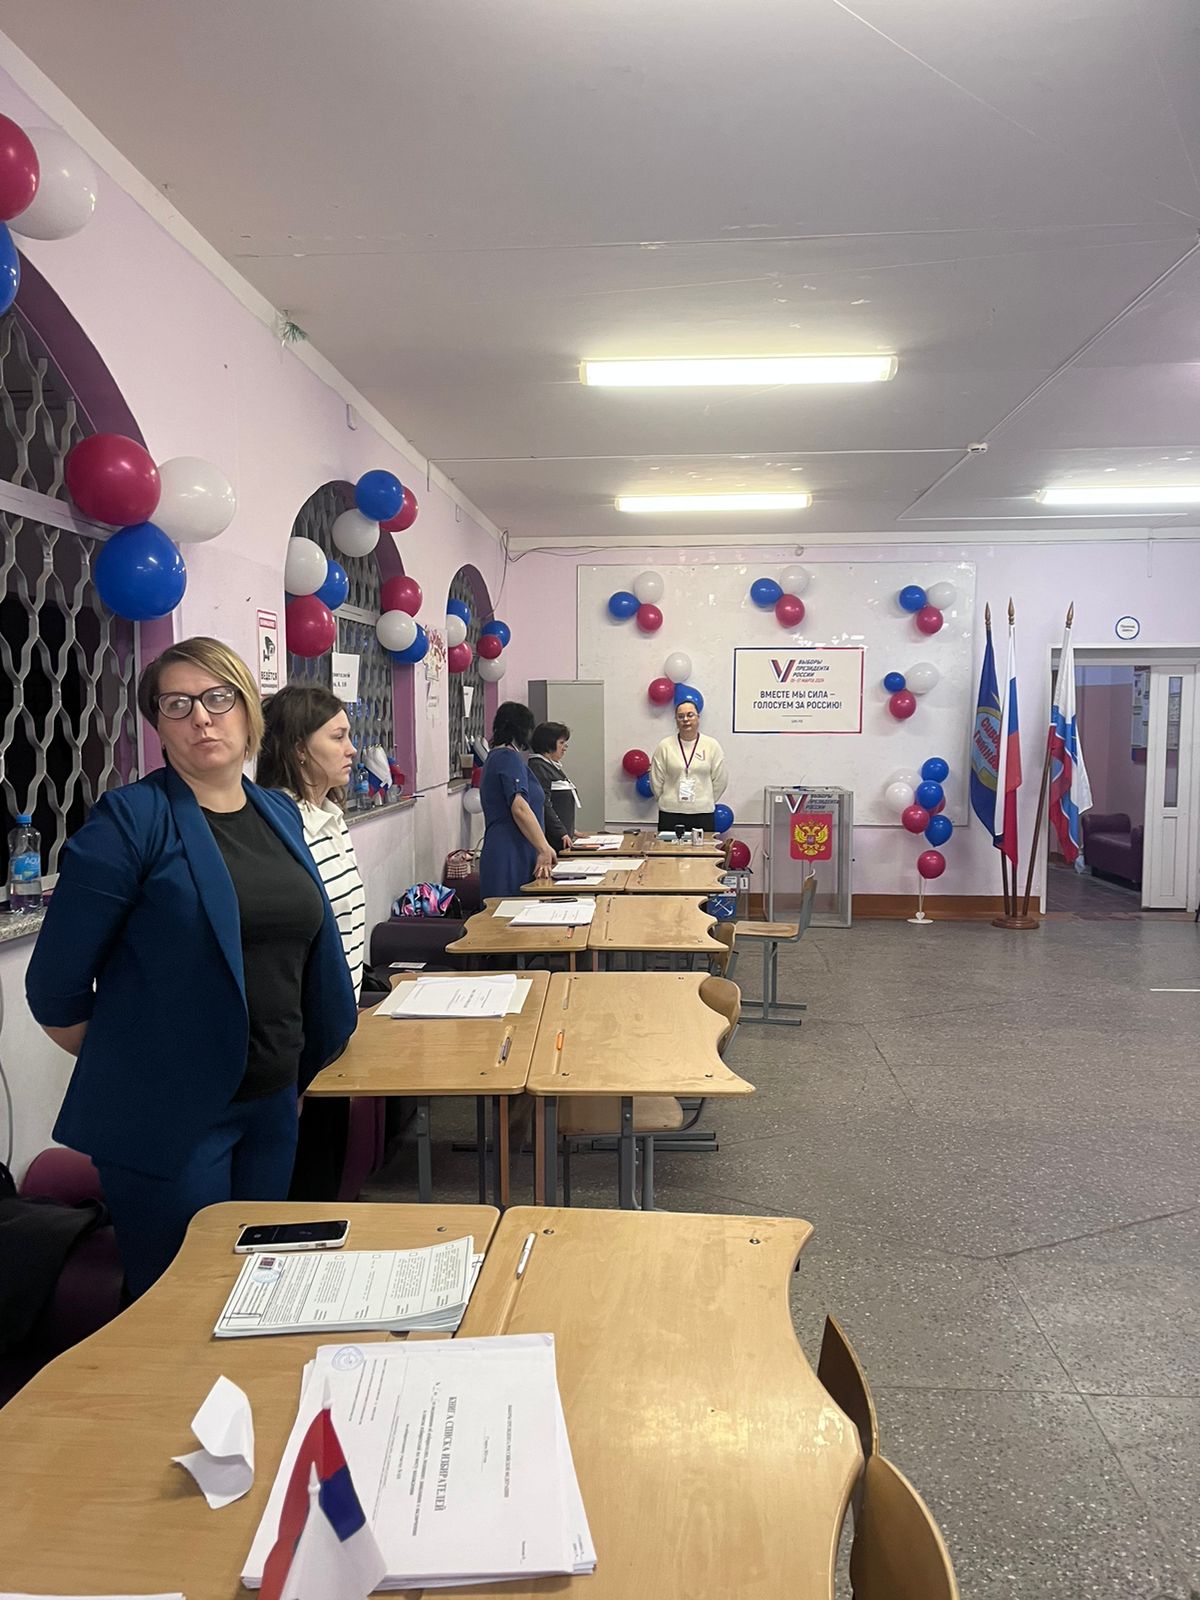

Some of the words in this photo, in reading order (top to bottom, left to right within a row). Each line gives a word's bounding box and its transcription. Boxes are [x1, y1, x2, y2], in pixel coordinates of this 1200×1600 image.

[760, 690, 790, 698] ВМЕСТЕ
[792, 690, 806, 698] МЫ
[808, 690, 828, 699] СИЛА
[807, 701, 842, 709] РОССИЮ!
[446, 1396, 458, 1420] КНИГА
[442, 1420, 455, 1452] СПИСКА
[434, 1453, 450, 1511] ИЗБИРАТЕЛЕЙ
